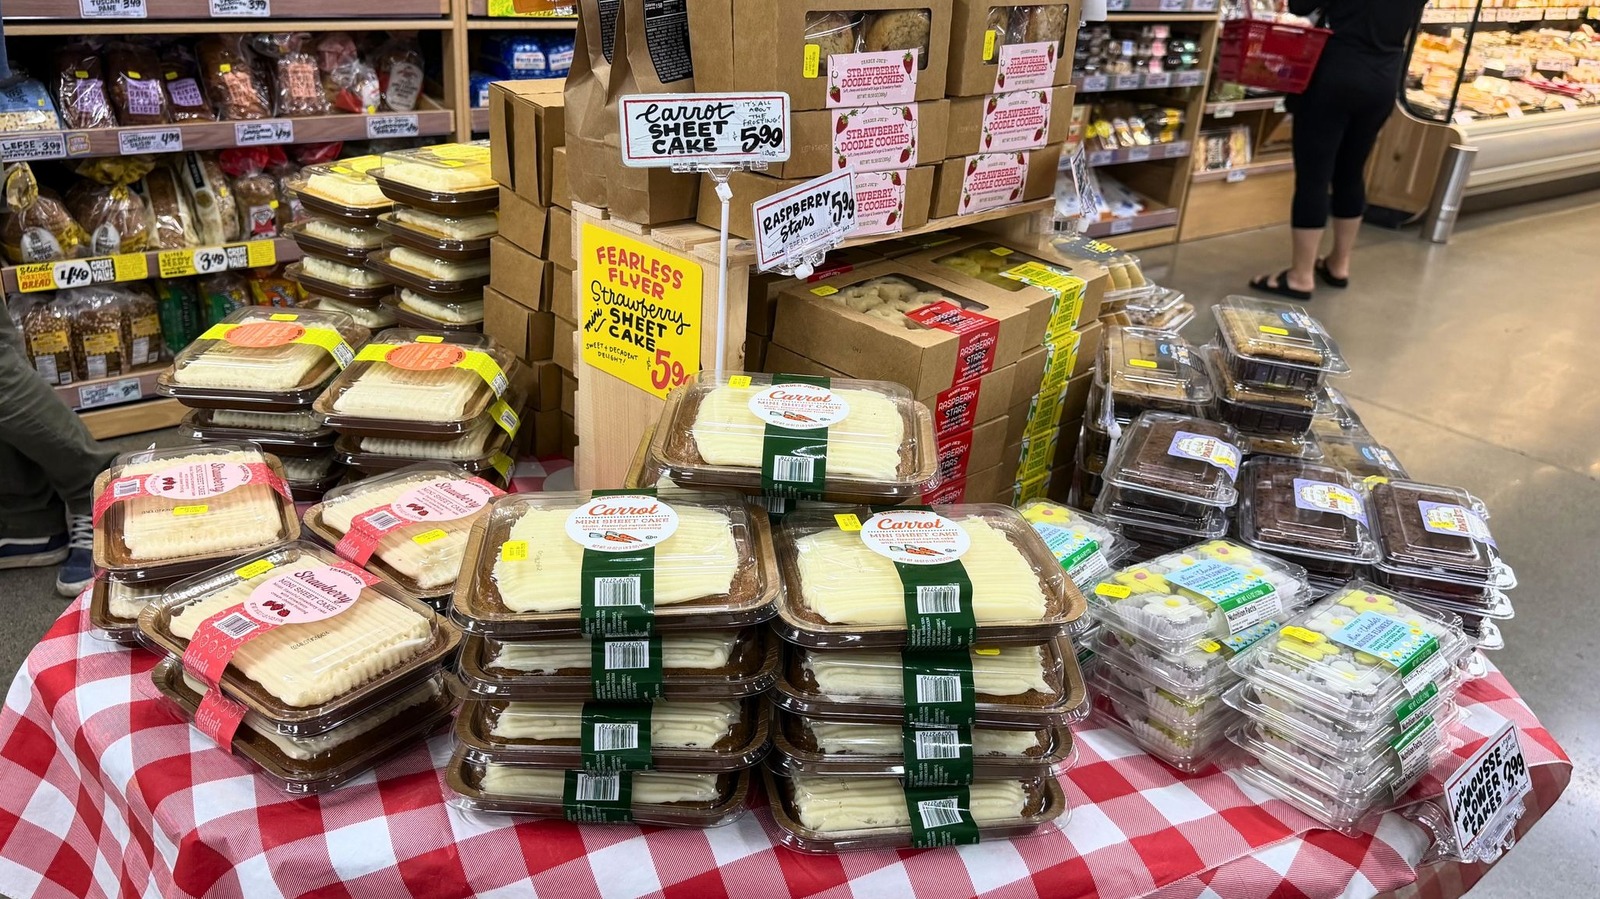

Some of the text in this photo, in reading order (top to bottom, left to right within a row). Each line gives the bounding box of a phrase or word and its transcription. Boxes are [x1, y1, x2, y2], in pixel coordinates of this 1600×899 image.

[1006, 63, 1048, 74] DOODLE COOKIES
[1010, 55, 1046, 66] STRAWBERRY
[846, 64, 900, 78] STRAWBERRY
[842, 74, 904, 88] DOODLE COOKIES
[636, 102, 735, 124] Carrot
[742, 115, 782, 126] FROSTING!
[994, 106, 1040, 120] STRAWBERRY
[648, 120, 728, 139] SHEET
[989, 116, 1044, 131] DOODLE COOKIES
[161, 132, 180, 145] 4.99
[846, 124, 904, 140] STRAWBERRY
[3, 140, 36, 150] LEFSE
[42, 142, 60, 150] 3.99
[652, 138, 718, 154] CAKE
[841, 139, 874, 152] DOODLE
[874, 134, 910, 146] COOKIES
[974, 167, 1018, 182] STRAWBERRY
[968, 176, 1020, 192] DOODLE COOKIES
[864, 198, 897, 211] COOKIES
[763, 191, 830, 235] RASPBERRY
[781, 213, 814, 244] Stars
[92, 259, 112, 270] GREAT
[200, 253, 224, 270] 3.49
[596, 246, 684, 290] FEARLESS
[22, 279, 51, 289] BREAD
[92, 270, 114, 282] VALUE
[608, 268, 665, 300] FLYER
[591, 280, 691, 336] Strawberry
[584, 302, 602, 332] mini
[610, 308, 668, 338] SHEET
[608, 326, 656, 352] CAKE
[960, 336, 996, 357] RASPBERRY
[598, 351, 626, 366] DELIGHT!
[609, 346, 639, 360] DECADENT
[966, 350, 987, 364] STARS
[769, 390, 832, 402] Carrot
[938, 390, 977, 412] RASPBERRY
[945, 404, 967, 418] STARS
[941, 457, 958, 470] TARS
[210, 462, 228, 492] Strawberry
[435, 482, 482, 508] Strawberry
[589, 504, 658, 516] Carrot
[877, 518, 944, 530] Carrot
[330, 567, 351, 577] TRADER
[278, 578, 337, 612] MINI SHEET CAKE
[294, 570, 353, 604] Strawberry
[1228, 604, 1256, 620] Nutrition Facts
[1354, 620, 1394, 648] MOUSSE FLOWERS
[1402, 710, 1424, 729] Nutrition Facts
[1401, 740, 1422, 760] Nutrition Facts
[1405, 770, 1414, 780] Facts
[1463, 746, 1502, 812] MOUSSE
[1454, 780, 1466, 822] mini
[1462, 772, 1500, 833] FLOWER
[1472, 790, 1502, 836] CAKES
